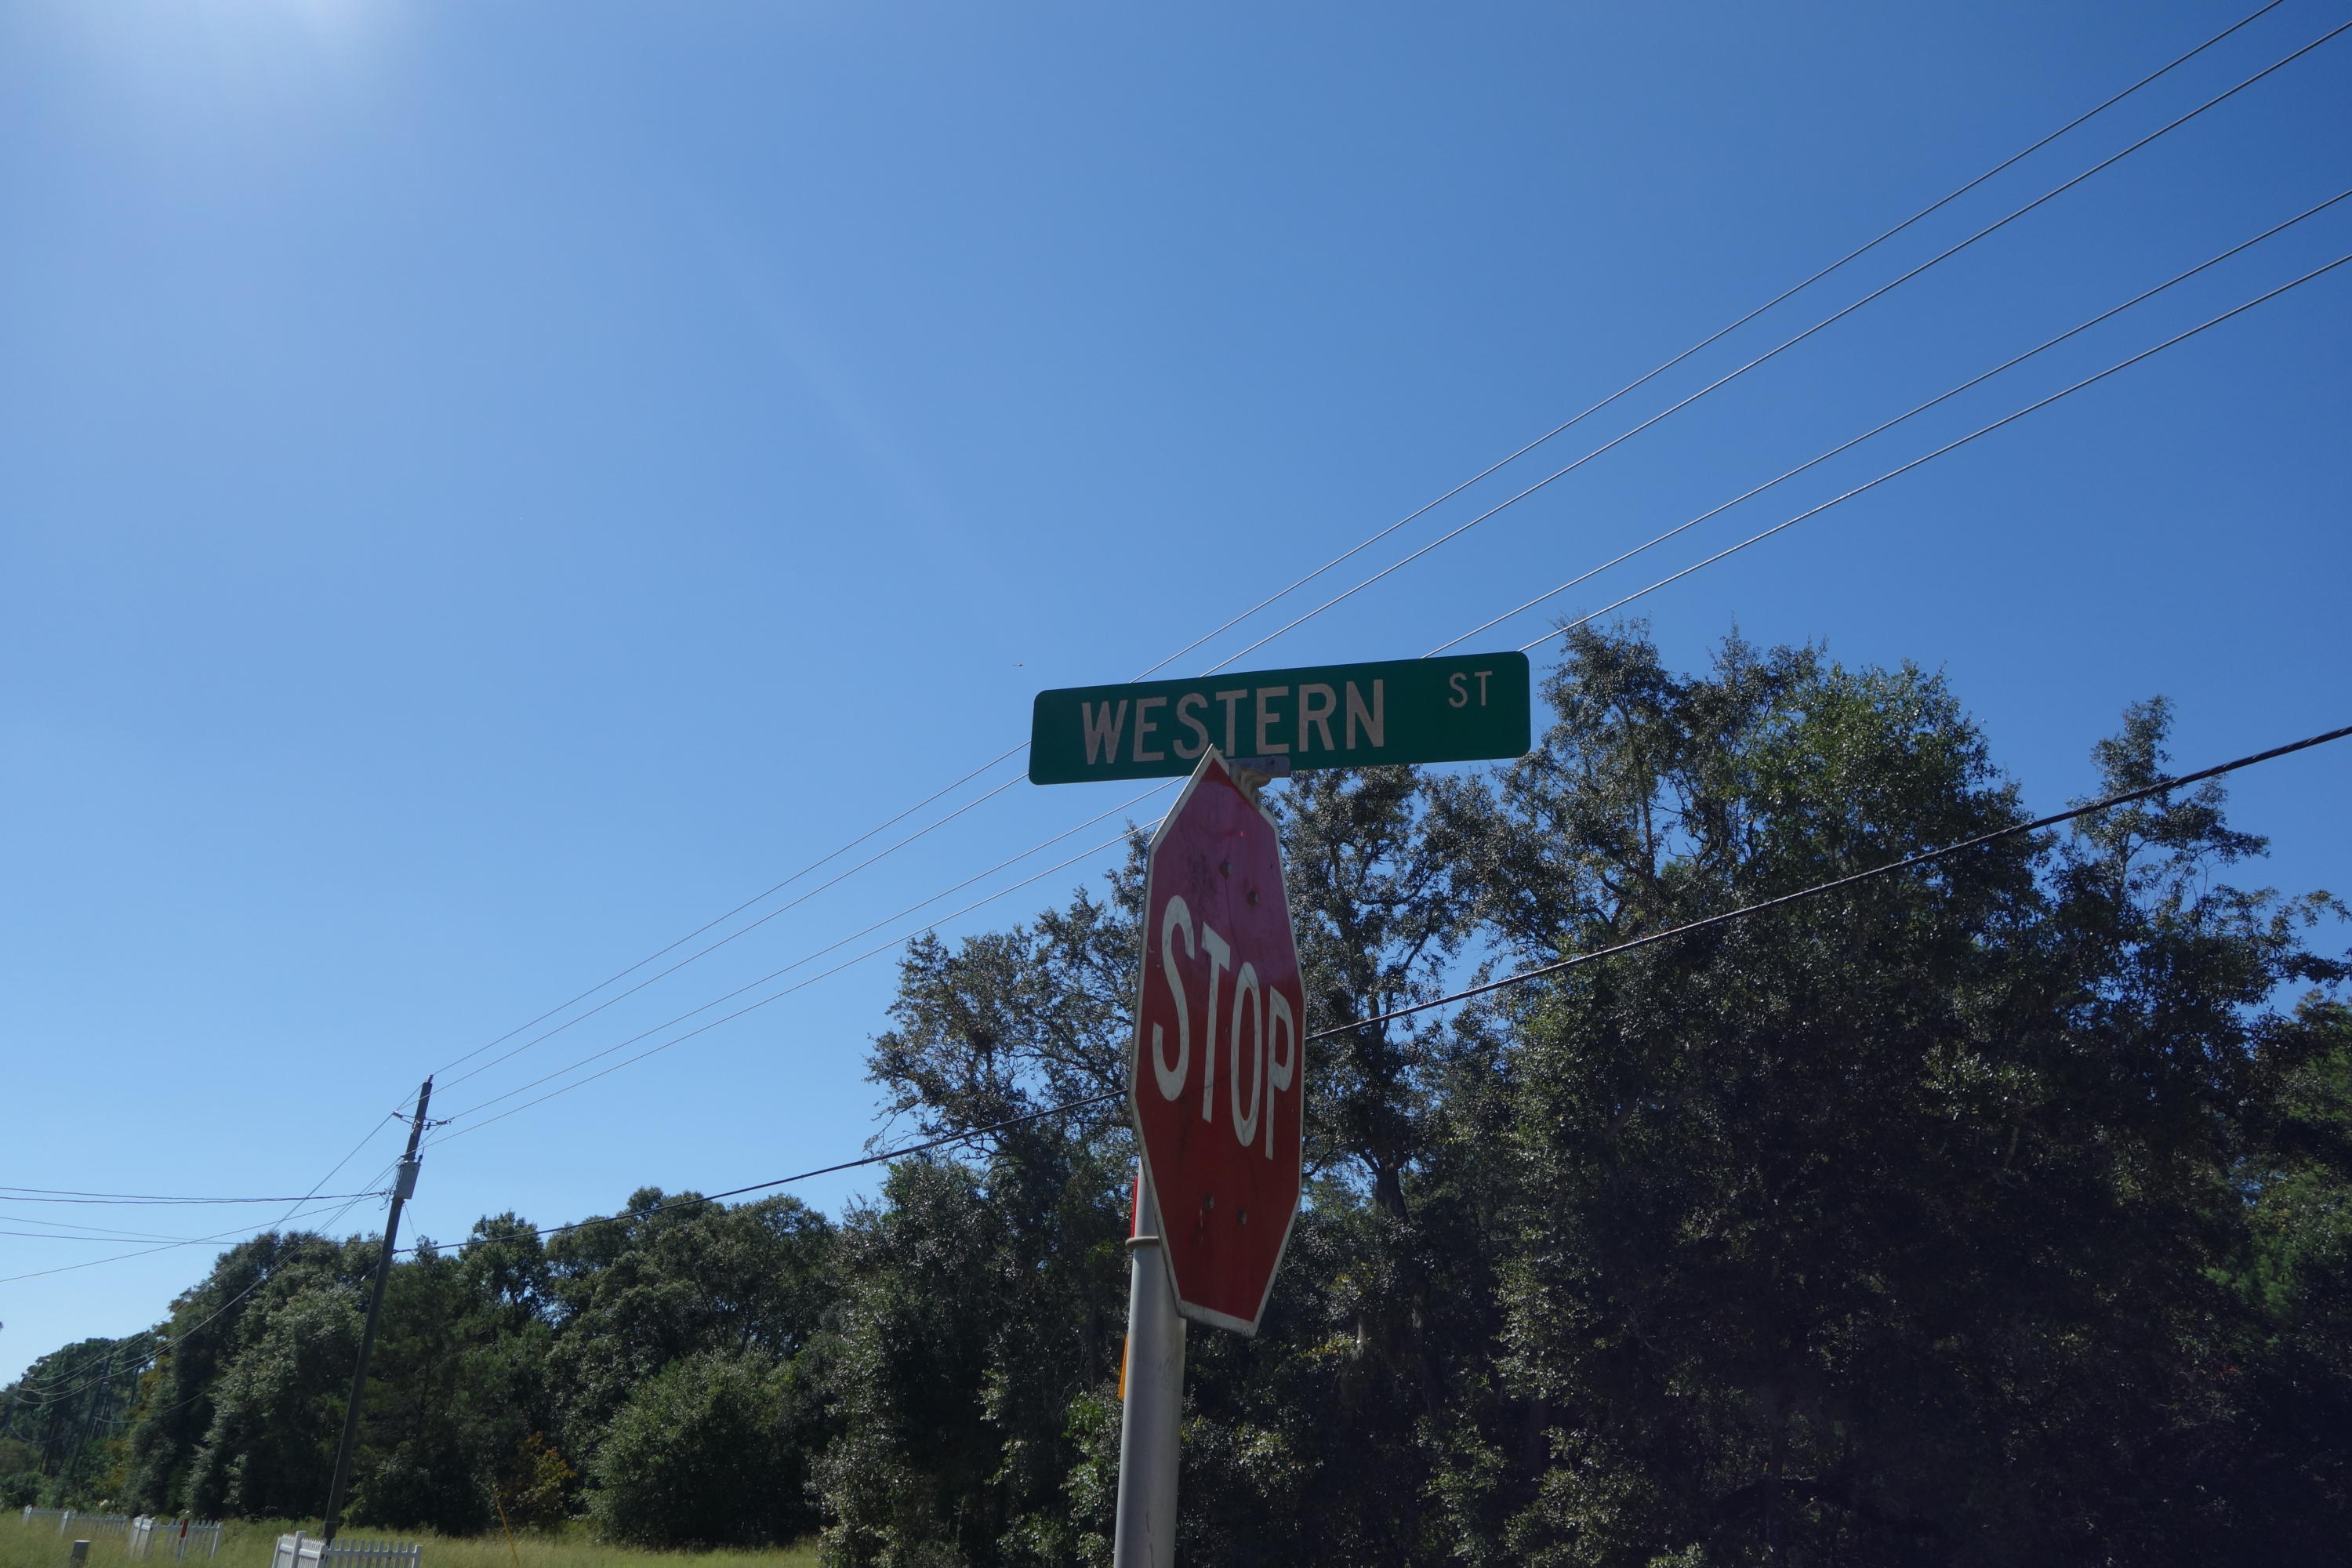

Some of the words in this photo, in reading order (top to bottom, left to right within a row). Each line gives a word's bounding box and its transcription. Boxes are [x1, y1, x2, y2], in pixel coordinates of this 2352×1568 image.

[1081, 680, 1384, 765] WESTERN
[1448, 671, 1493, 708] ST
[1152, 895, 1294, 1161] STOP
